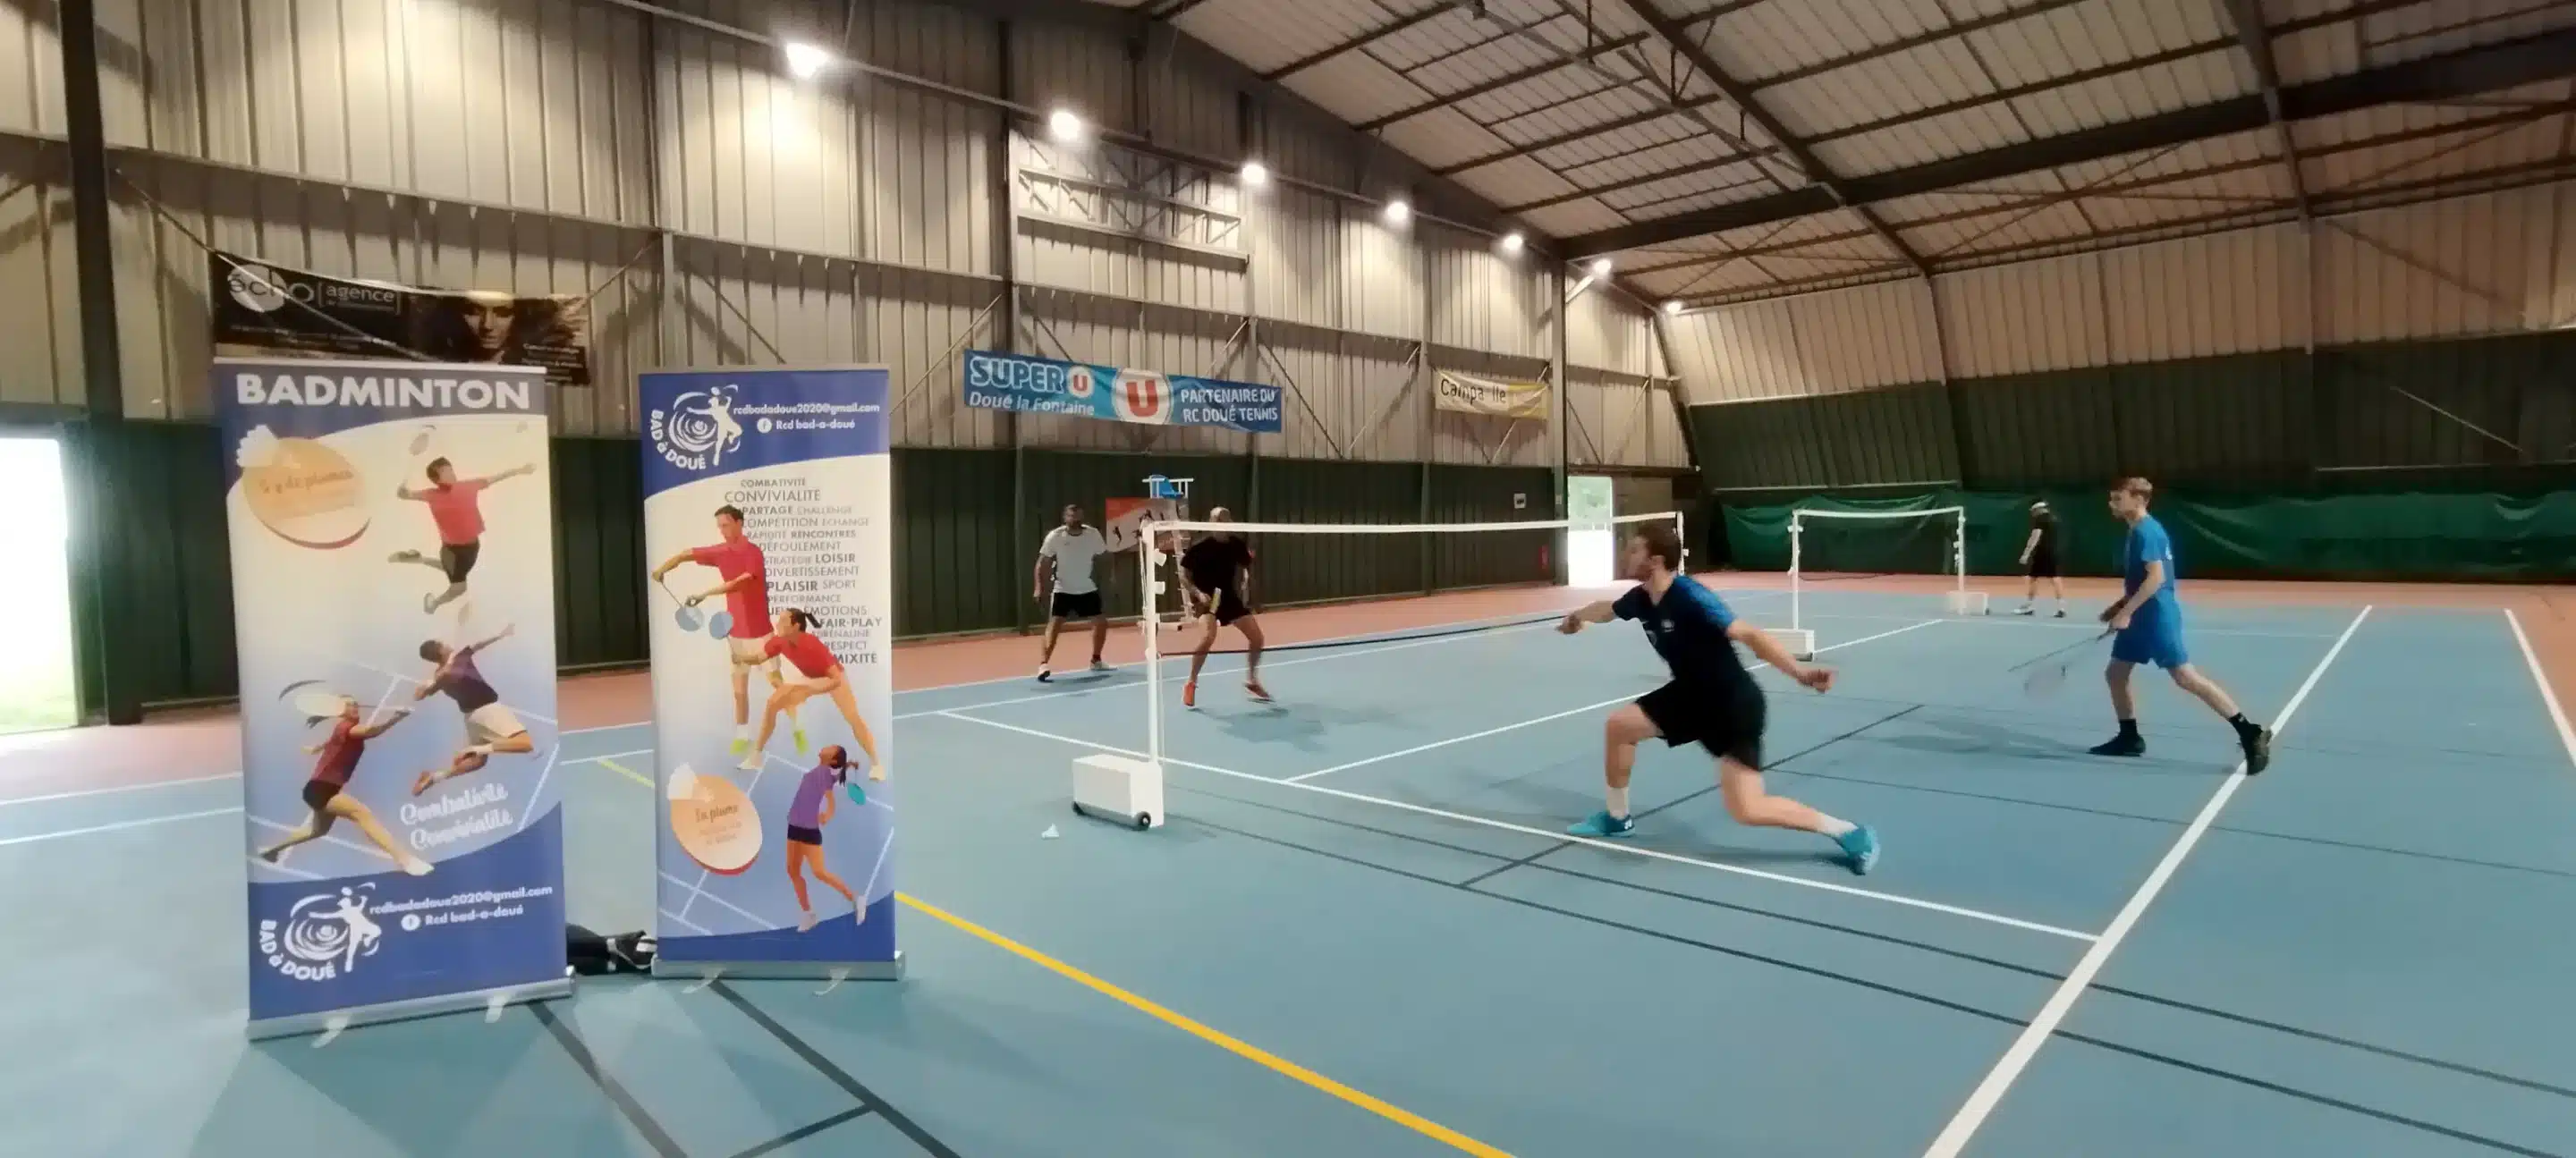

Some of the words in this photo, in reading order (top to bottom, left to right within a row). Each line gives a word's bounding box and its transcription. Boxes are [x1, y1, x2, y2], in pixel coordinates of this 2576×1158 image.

[326, 284, 395, 303] agence
[970, 355, 1065, 393] SUPER
[1072, 374, 1089, 392] U
[236, 373, 530, 409] BADMINTON
[1125, 379, 1160, 418] U
[1181, 388, 1259, 404] PARTENAIRE
[1260, 390, 1276, 403] DU
[969, 391, 1013, 409] Doué
[1016, 396, 1030, 410] la
[1032, 399, 1095, 417] Fontaine
[1182, 408, 1200, 423] RC
[1202, 404, 1236, 423] DOUÉ
[1240, 406, 1278, 422] TENNIS
[775, 419, 794, 430] Rcd
[649, 409, 664, 439] BAD
[665, 451, 707, 470] DOUÉ
[791, 529, 857, 539] RENCONTRES
[815, 554, 857, 563] LOISIR
[766, 565, 860, 577] DIVERTISSEMENT
[767, 581, 818, 592] PLAISIR
[822, 579, 856, 589] SPORT
[768, 594, 842, 604] PERFORMANCE
[820, 617, 883, 628] FAIR-PLAY
[259, 919, 277, 955] BAD
[280, 960, 336, 982] DOUÉ
